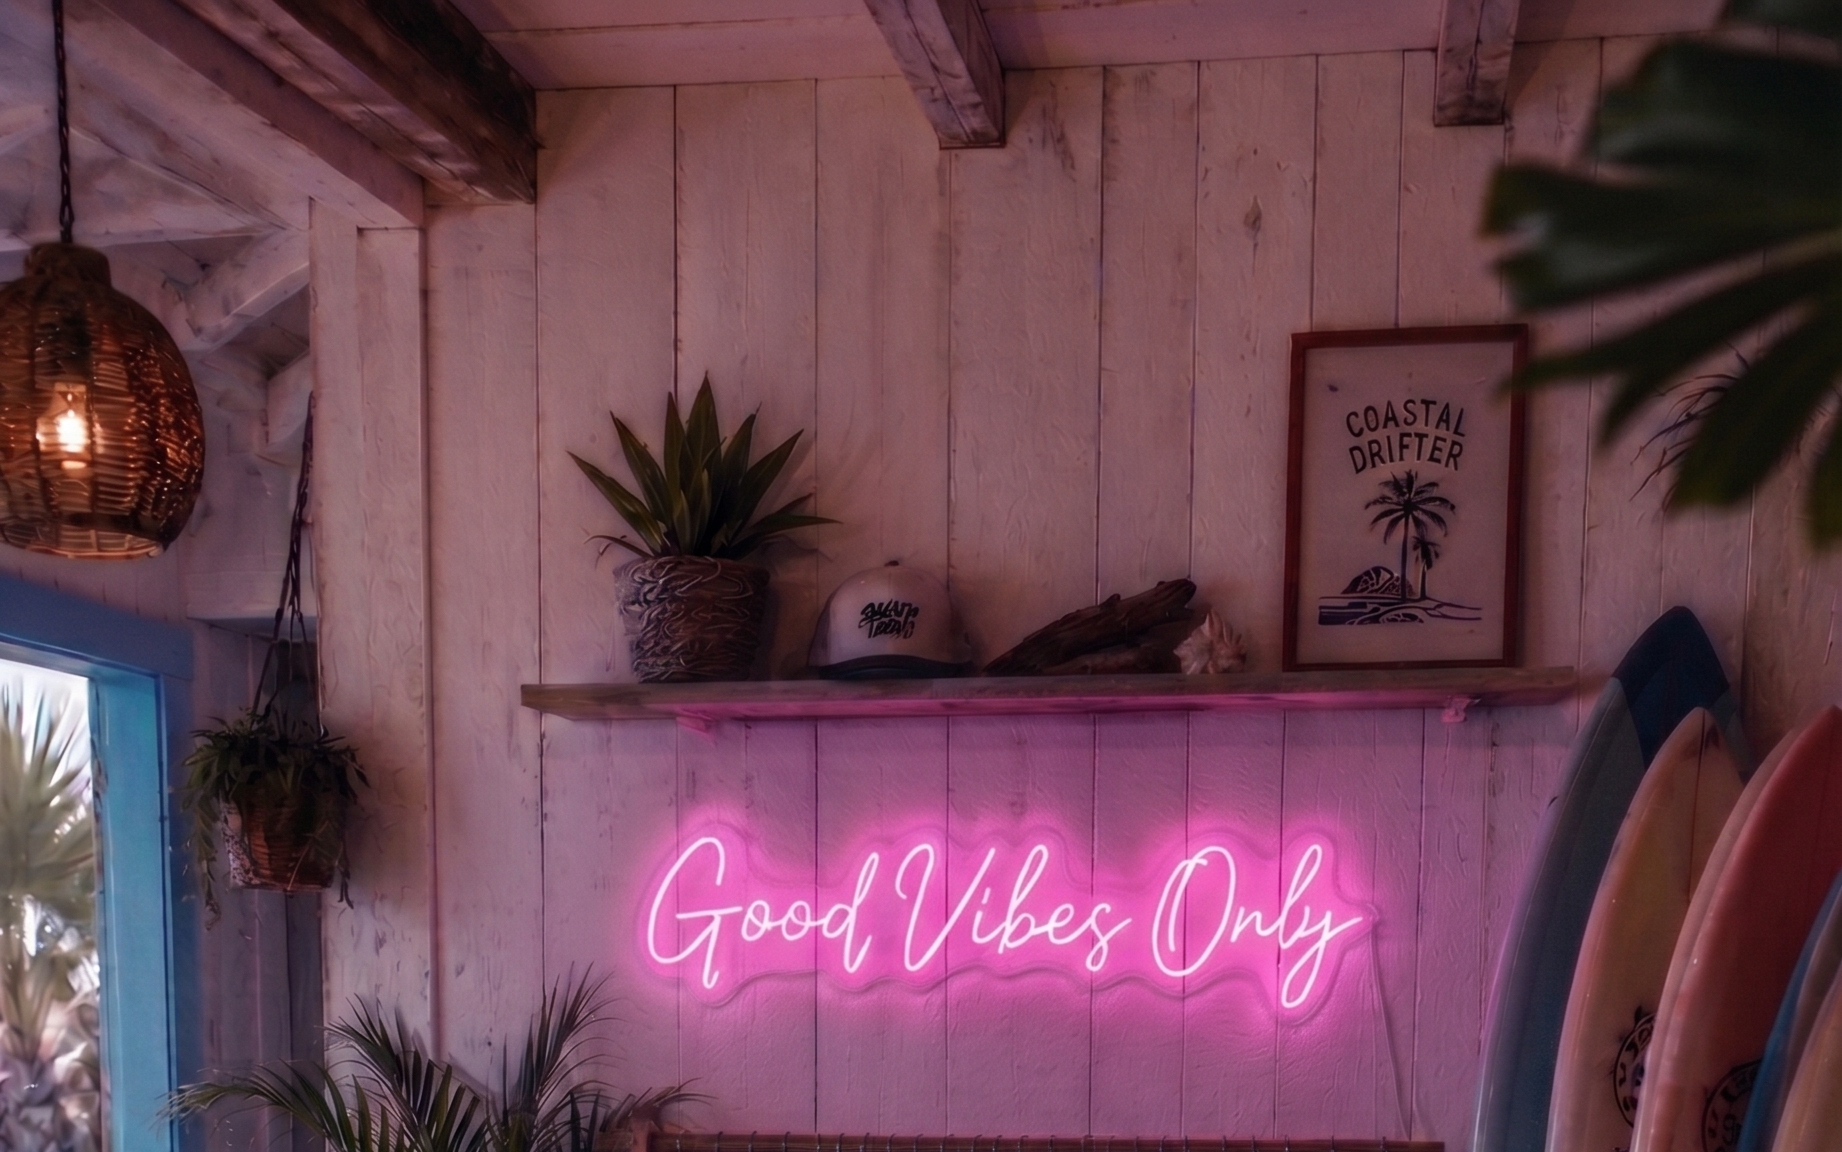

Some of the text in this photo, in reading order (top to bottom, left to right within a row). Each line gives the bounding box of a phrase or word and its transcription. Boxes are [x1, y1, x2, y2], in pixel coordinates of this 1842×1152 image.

[1345, 398, 1466, 438] COASTAL
[1348, 431, 1464, 475] DRIFTER
[646, 836, 1364, 1009] Good Vibes Only
